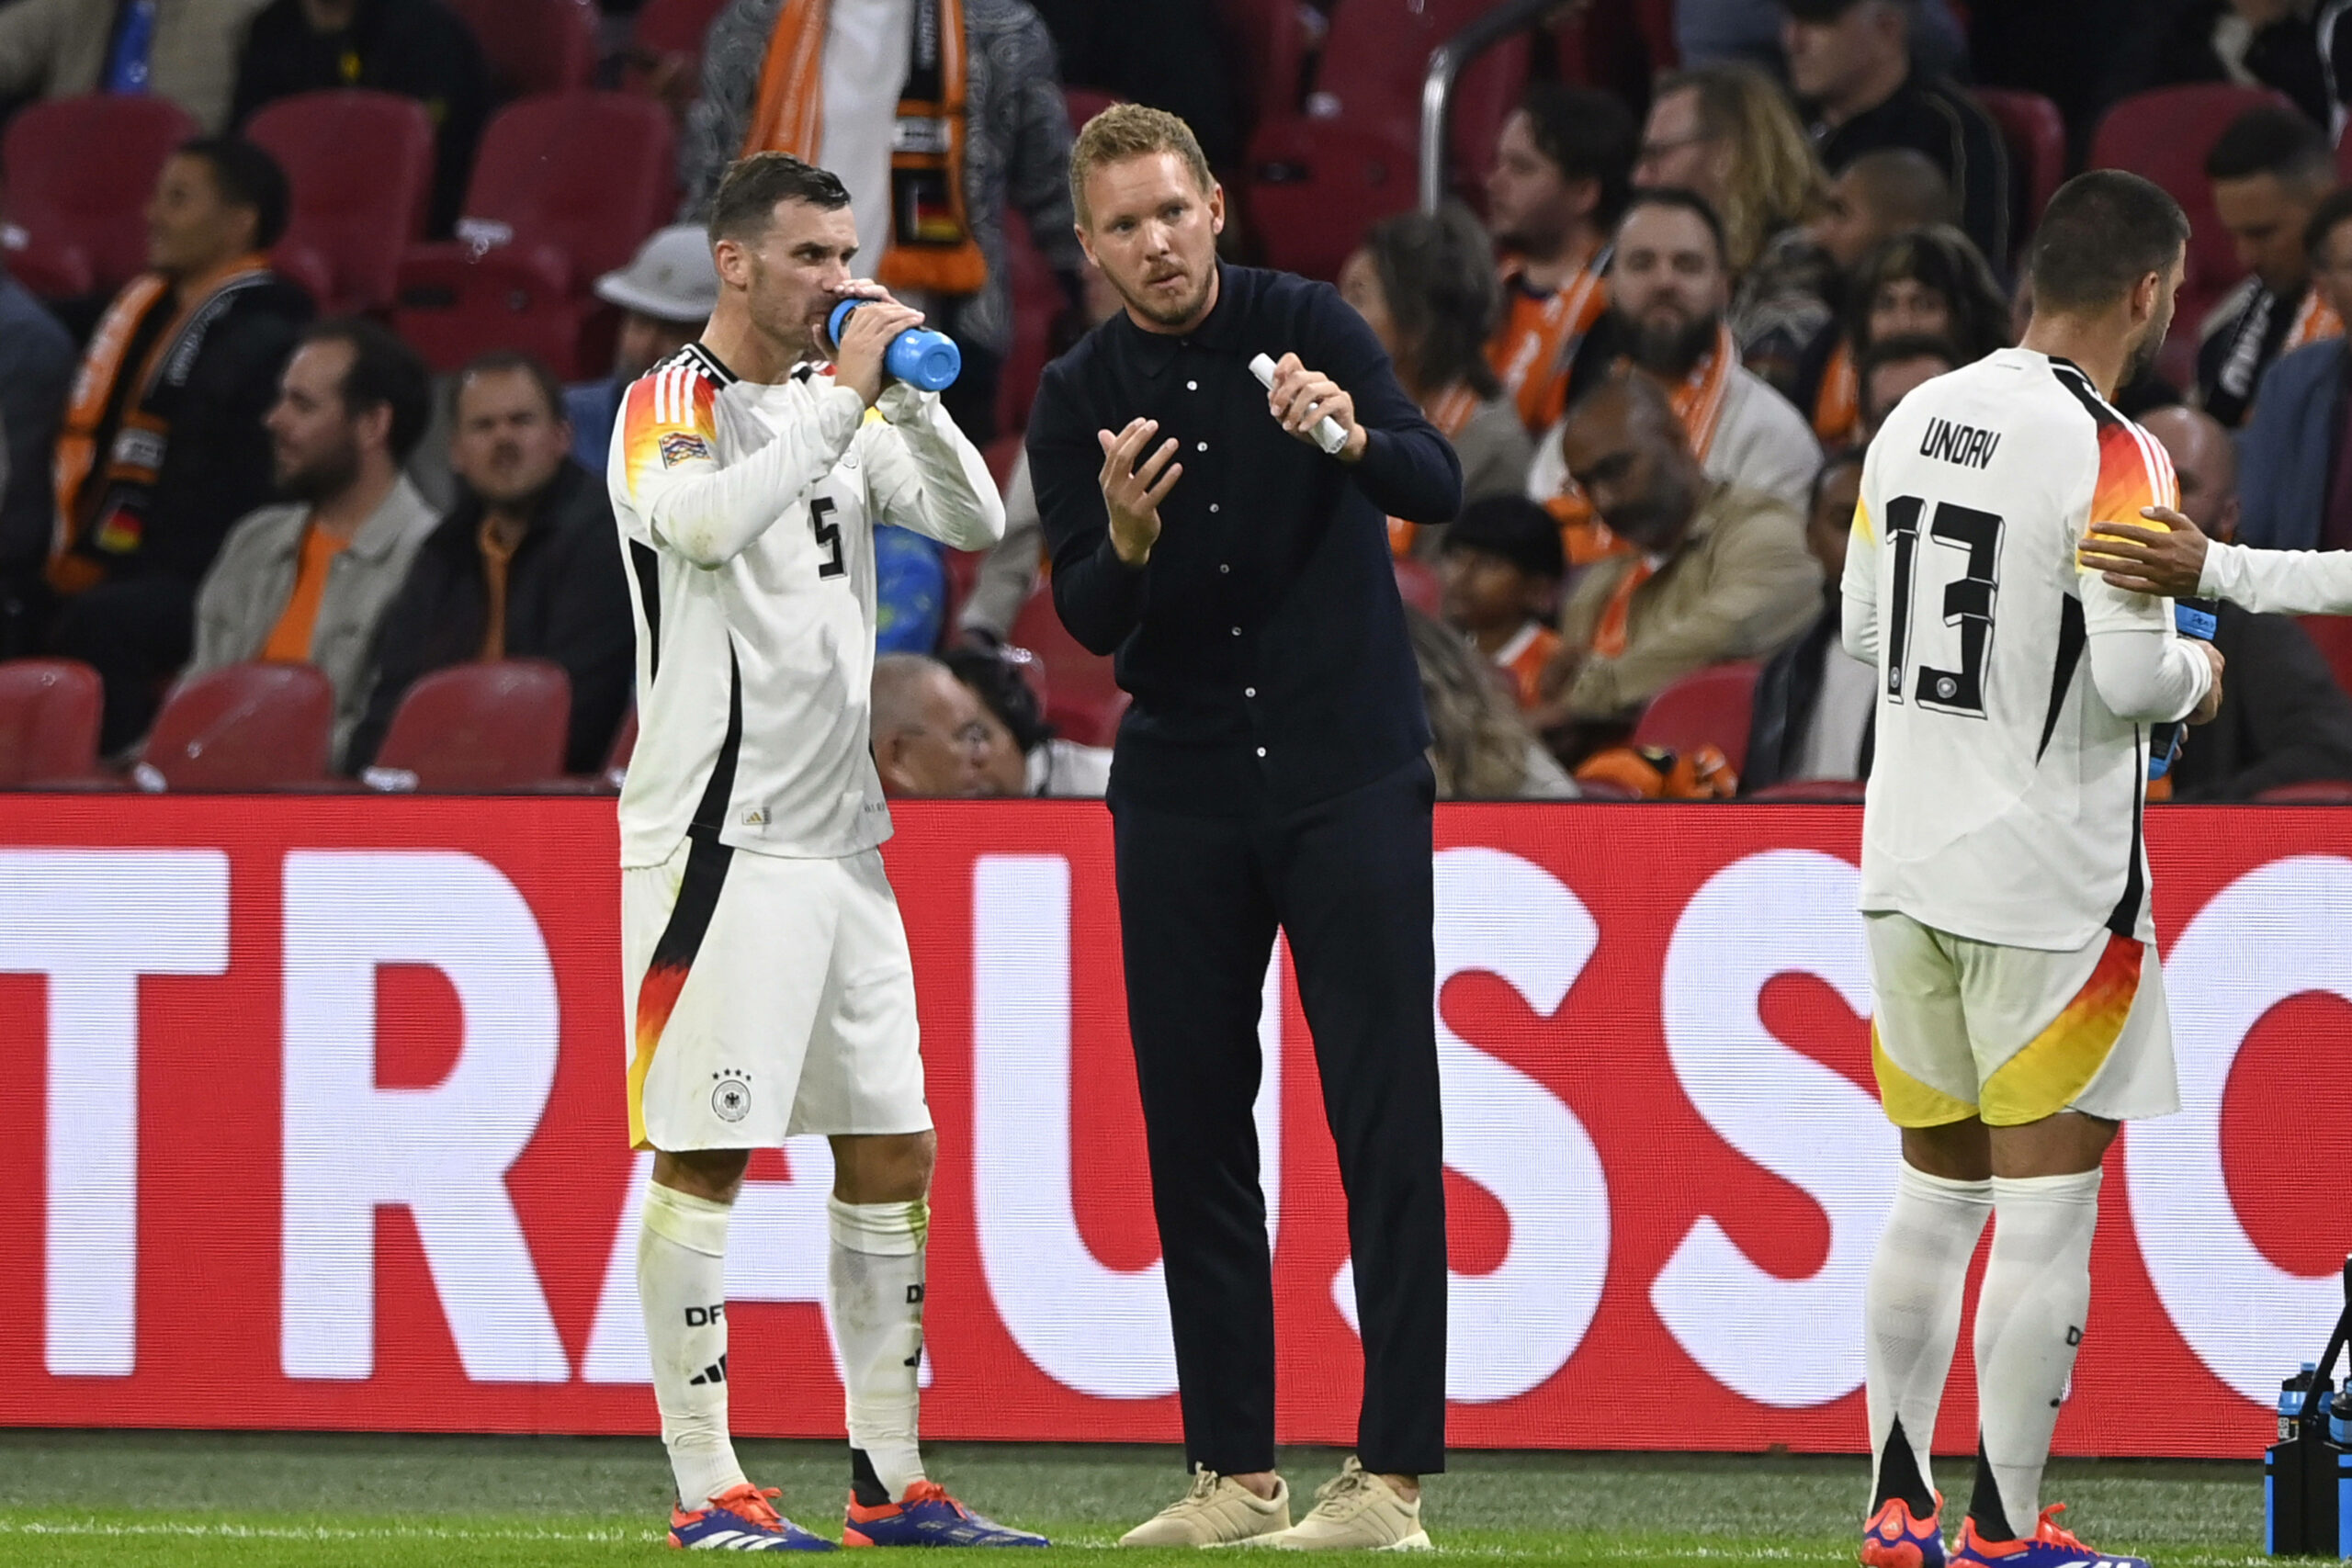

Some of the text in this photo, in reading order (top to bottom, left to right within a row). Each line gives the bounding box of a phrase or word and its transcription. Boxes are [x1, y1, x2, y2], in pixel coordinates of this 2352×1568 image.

[1919, 416, 2001, 469] UNDAV
[810, 496, 847, 581] 5
[1885, 494, 2006, 720] 13
